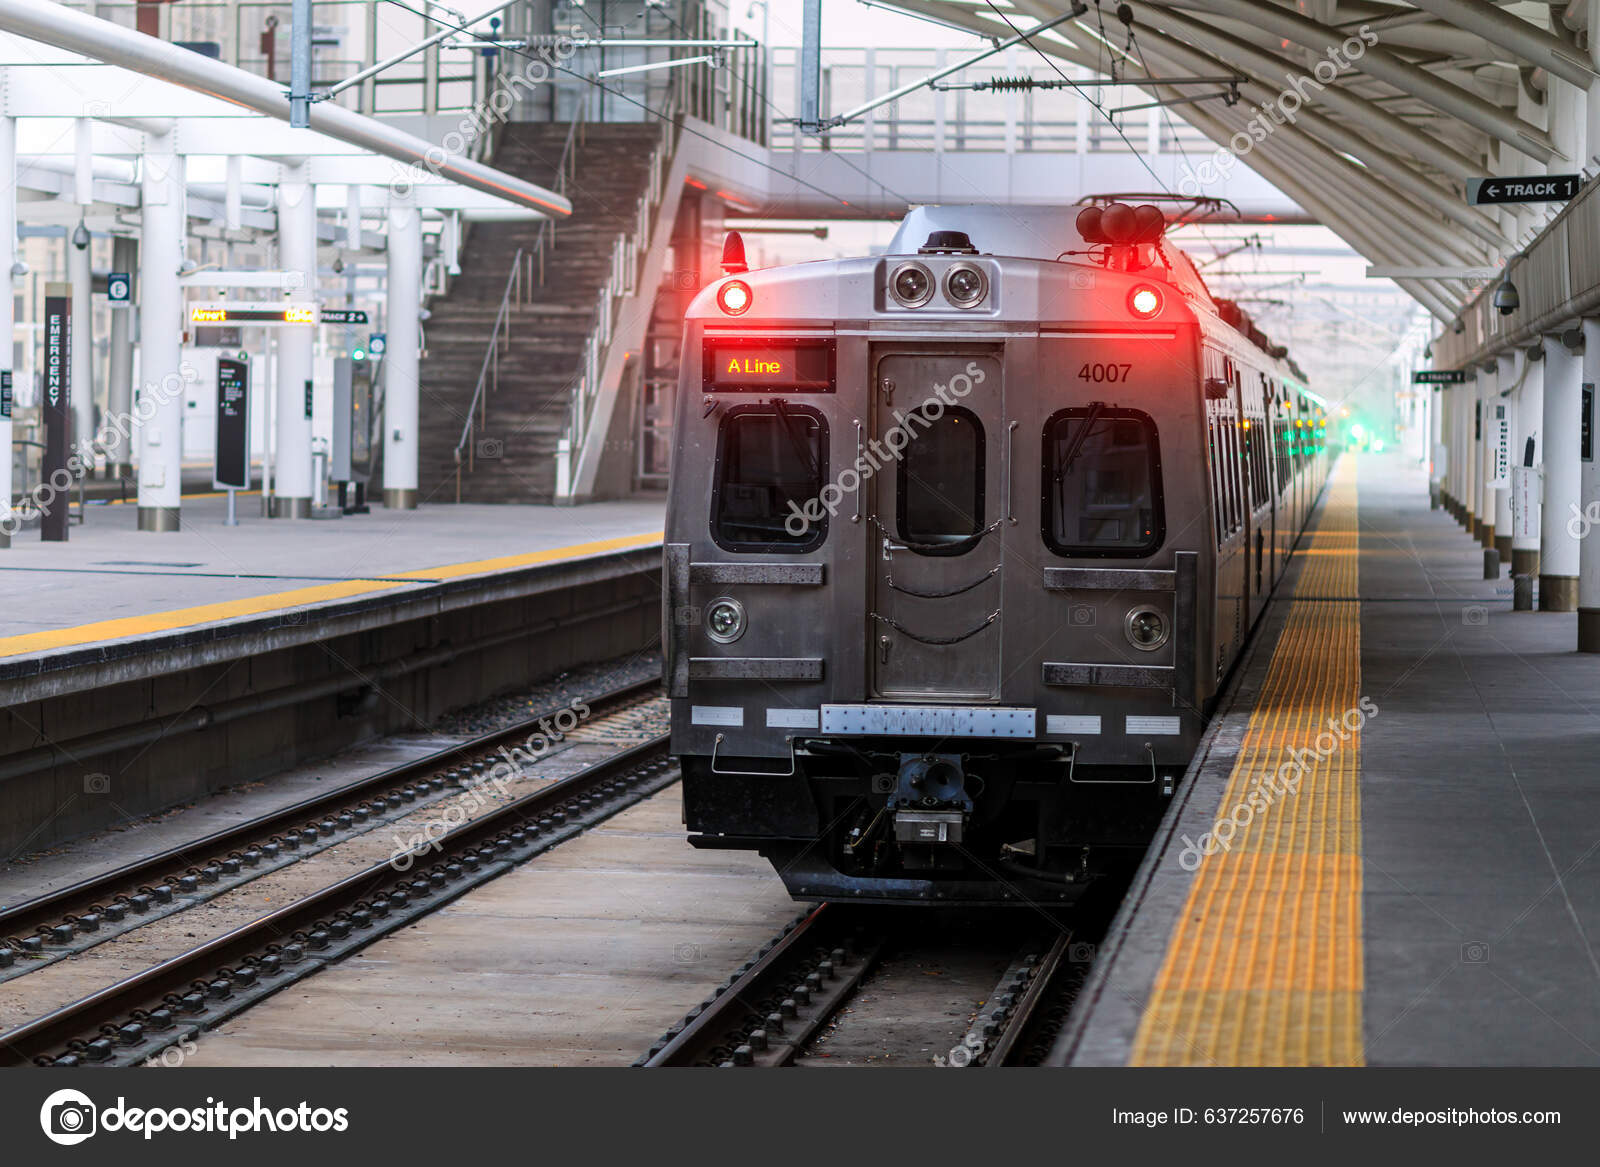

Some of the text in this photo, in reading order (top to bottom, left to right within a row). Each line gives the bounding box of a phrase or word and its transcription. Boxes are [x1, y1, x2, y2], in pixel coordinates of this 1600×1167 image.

[1505, 181, 1572, 196] TRACK 1
[348, 312, 356, 322] 2
[49, 314, 61, 407] EMERGENCY
[728, 358, 781, 373] A Line
[1078, 363, 1132, 383] 4007
